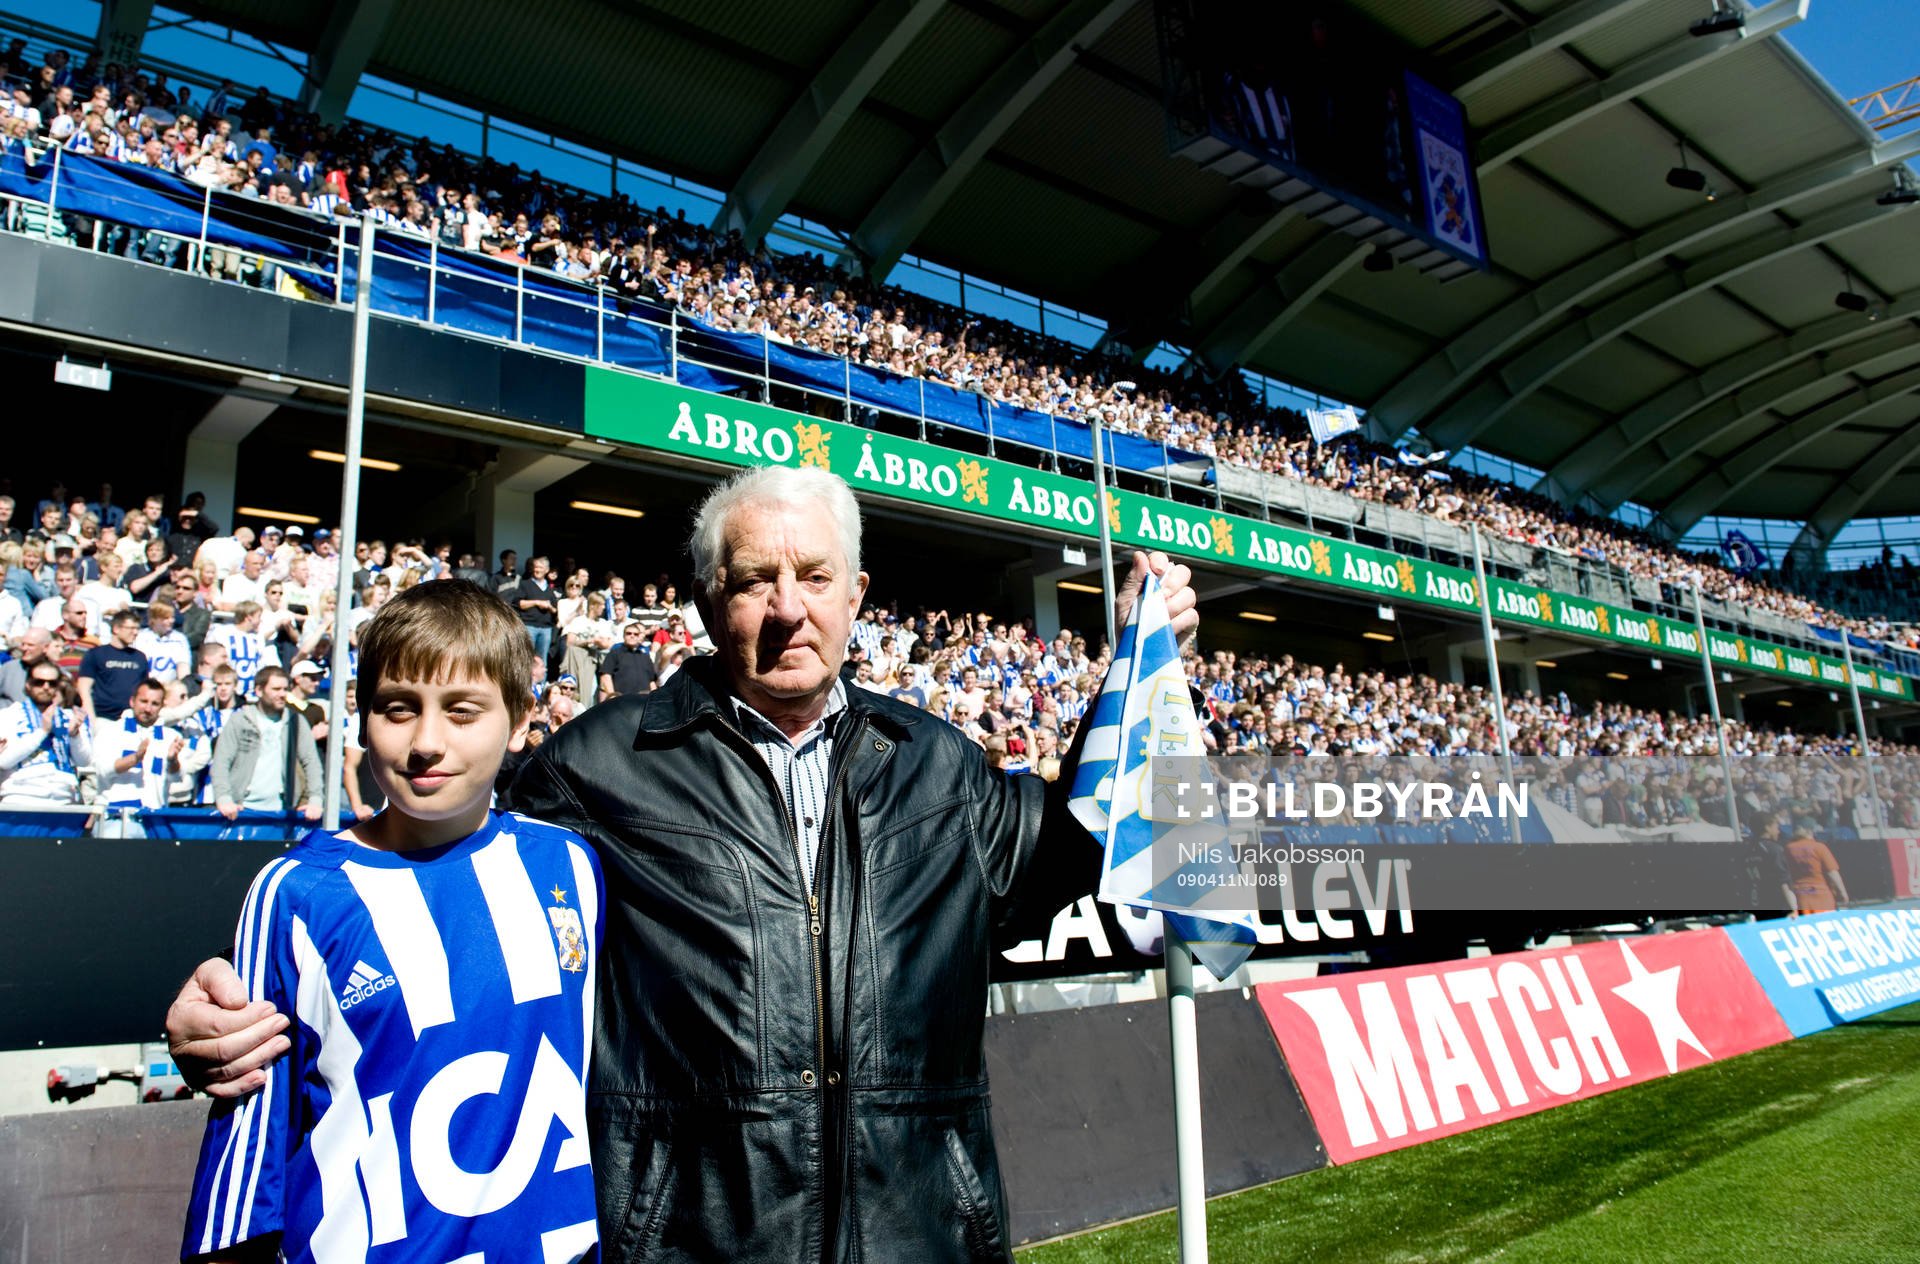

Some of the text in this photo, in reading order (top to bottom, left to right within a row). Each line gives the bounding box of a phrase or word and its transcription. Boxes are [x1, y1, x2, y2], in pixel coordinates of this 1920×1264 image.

[668, 402, 794, 463] ÅBRO
[855, 443, 958, 498] ÅBRO
[1008, 478, 1095, 526] ÅBRO
[1138, 508, 1211, 551] ÅBRO
[1247, 531, 1312, 571] ÅBRO
[1343, 551, 1398, 589] ÅBRO
[1426, 571, 1474, 605] ÅBRO
[1497, 587, 1540, 619] ÅBRO
[1560, 602, 1599, 631] ÅBRO
[1616, 614, 1650, 642] ÅBRO
[1665, 626, 1696, 652] ÅBRO
[1710, 637, 1739, 662] ÅBRO
[340, 975, 396, 1010] adidas
[1759, 908, 1920, 988] EHRENBORG
[360, 1031, 593, 1247] ICA
[1284, 955, 1631, 1148] MATCH
